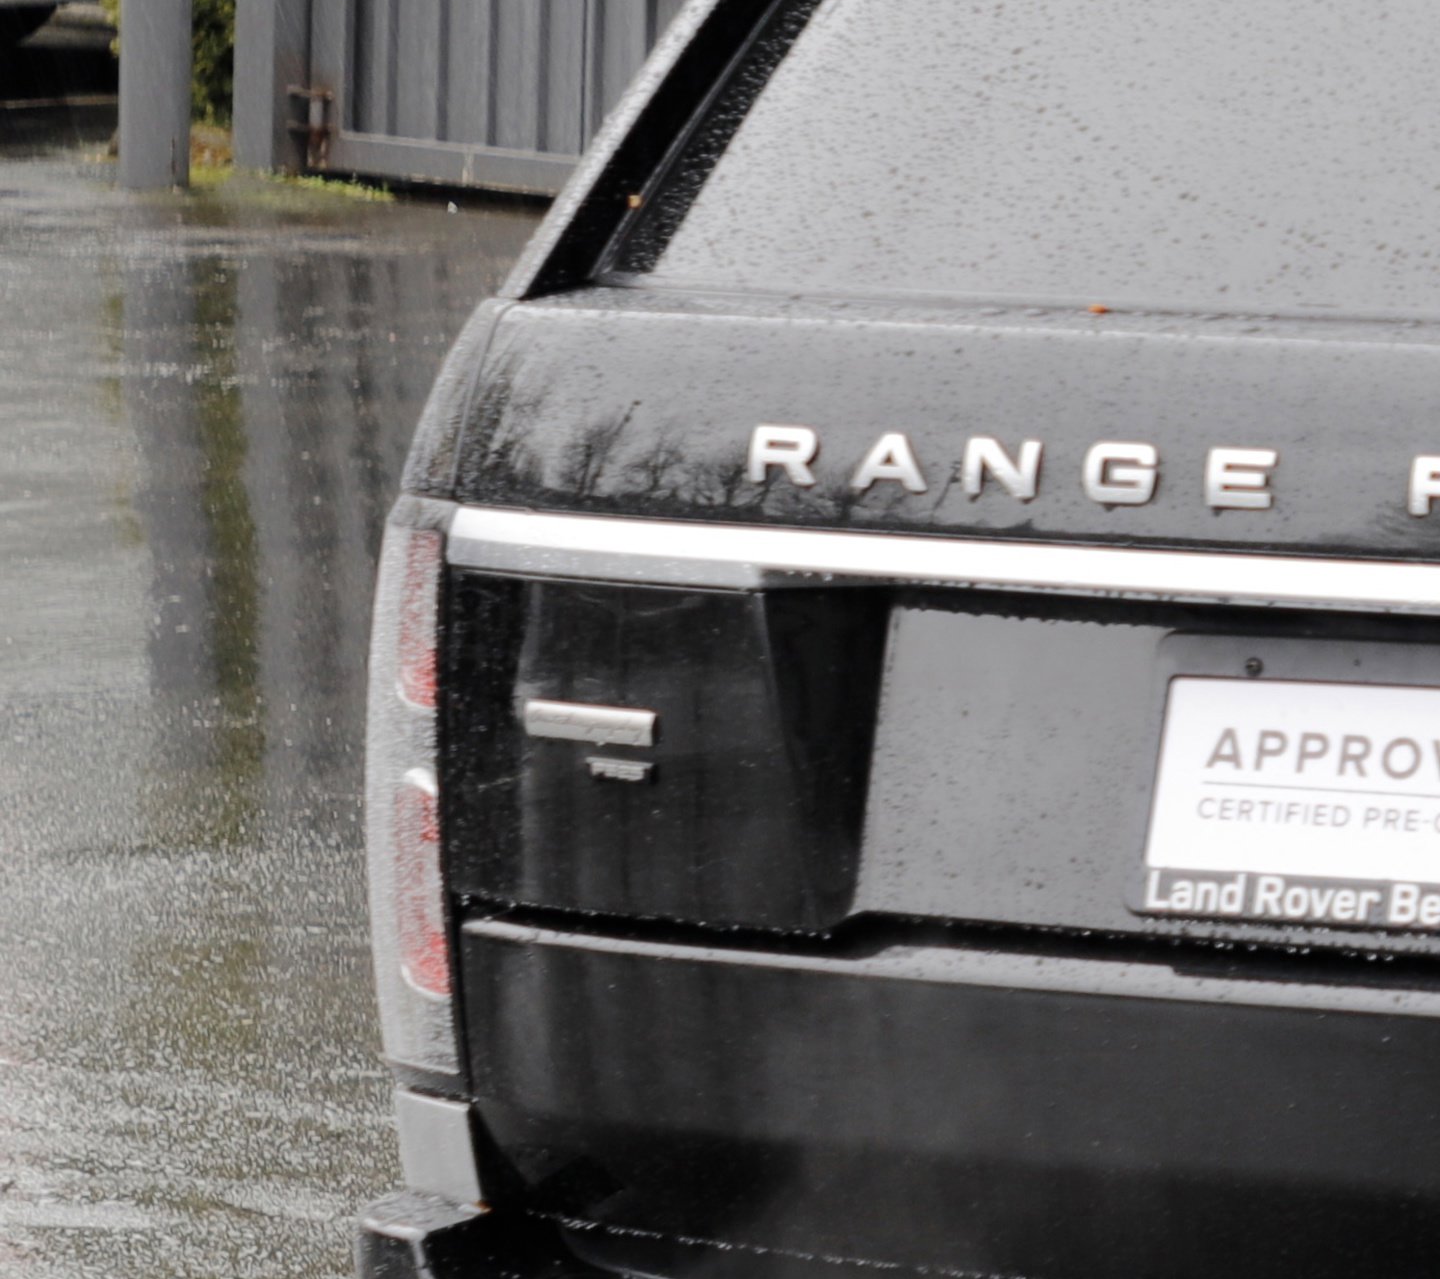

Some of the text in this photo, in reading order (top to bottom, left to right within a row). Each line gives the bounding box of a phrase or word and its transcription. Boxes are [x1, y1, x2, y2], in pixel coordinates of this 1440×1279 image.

[749, 424, 1277, 511] RANGE
[1197, 797, 1351, 828] CERTIFIED
[1144, 869, 1247, 914] Land
[1253, 876, 1380, 921] Rover
